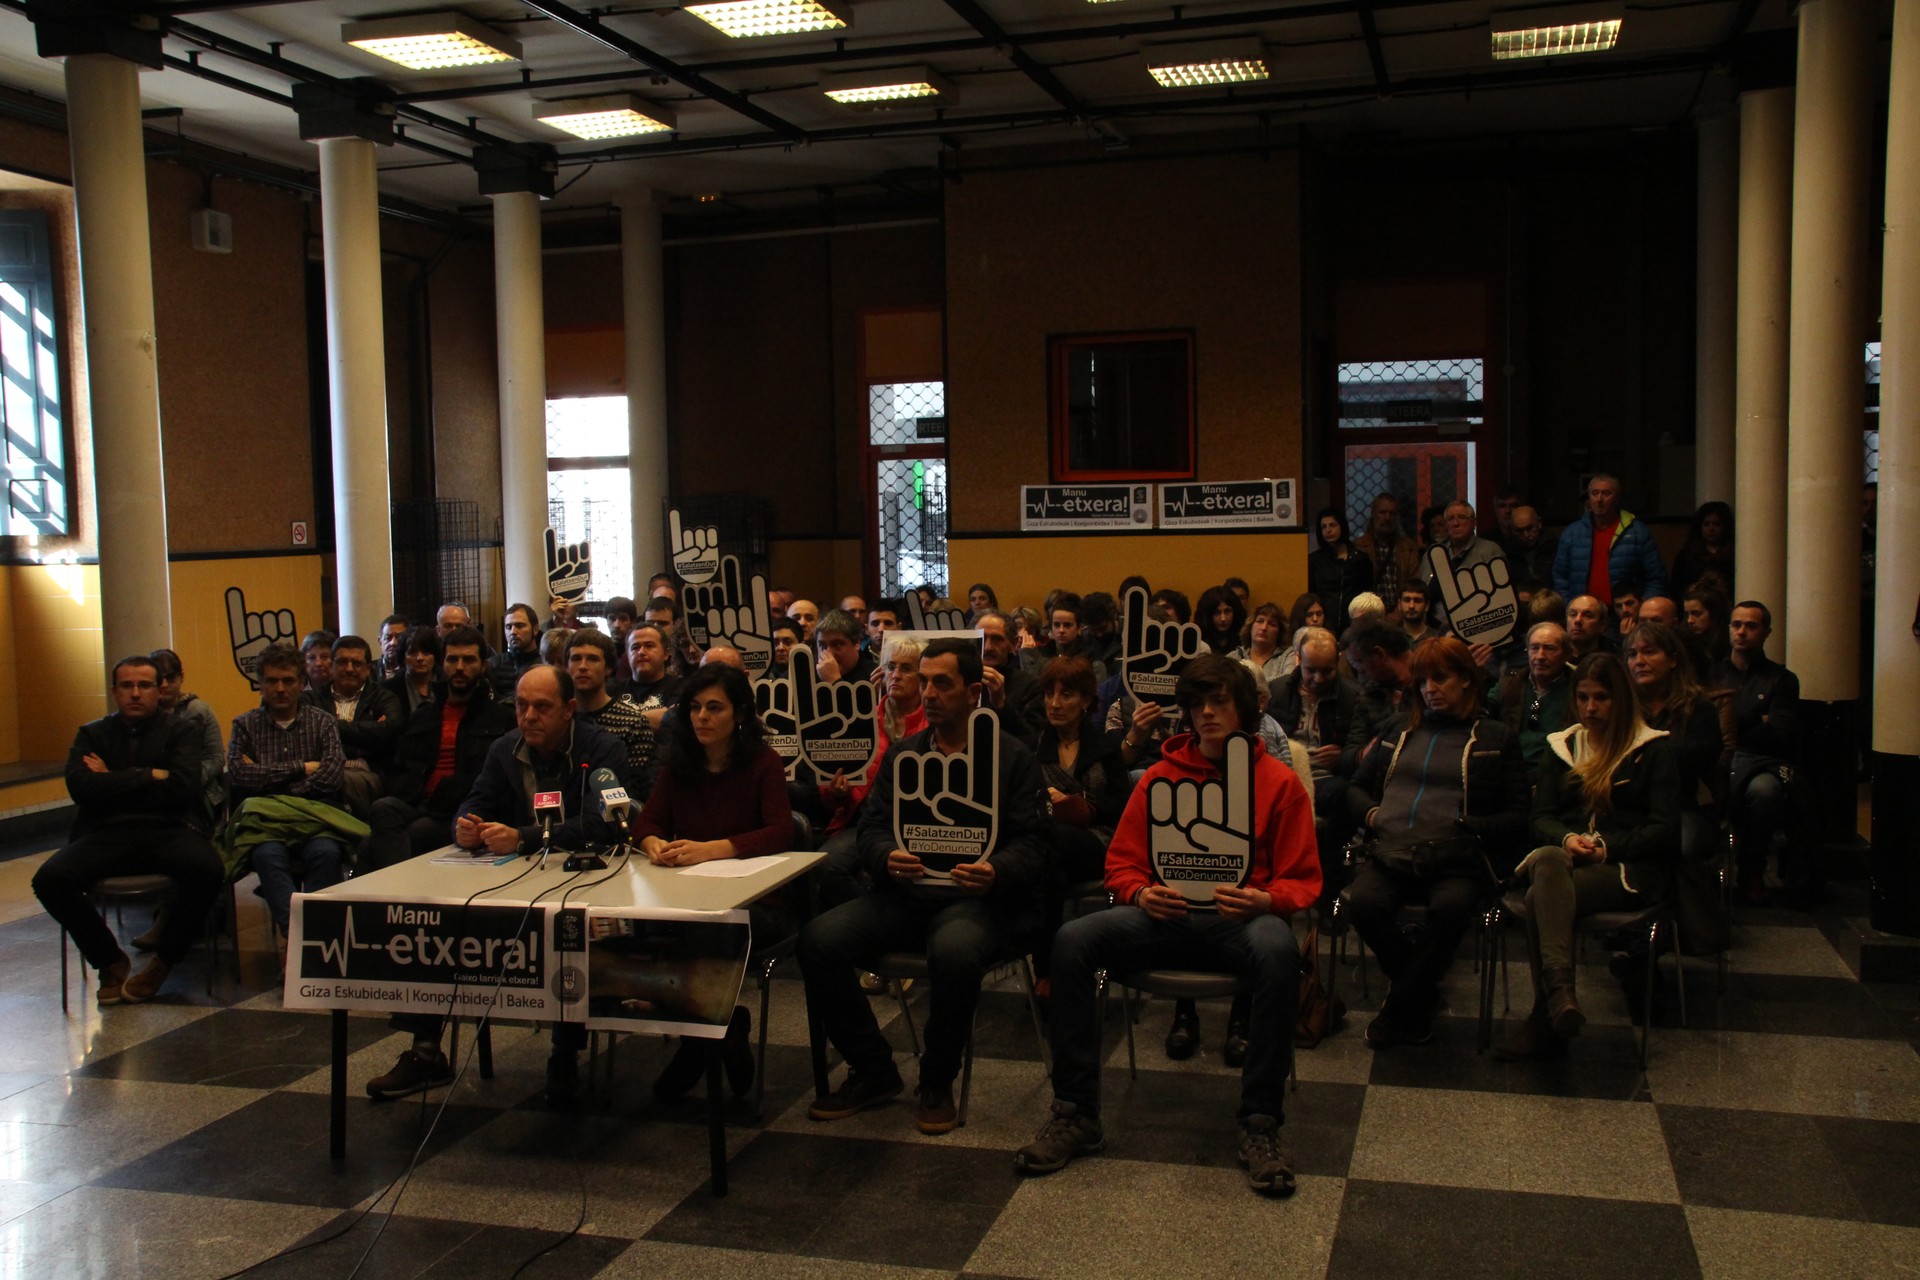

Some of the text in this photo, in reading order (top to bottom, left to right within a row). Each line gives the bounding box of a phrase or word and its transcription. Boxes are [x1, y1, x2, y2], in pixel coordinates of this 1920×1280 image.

[1062, 488, 1087, 497] Manu
[1201, 485, 1227, 494] Manu
[1063, 496, 1128, 513] etxera!
[1203, 491, 1270, 509] etxera!
[1458, 605, 1514, 628] #SalatzenDut
[1131, 674, 1180, 684] #SalatzenD
[807, 740, 870, 750] #SalatzenDut
[812, 752, 867, 760] #YoDenuncio
[605, 791, 626, 800] etb
[906, 826, 985, 840] #SalatzenDut
[911, 841, 980, 854] #YoDenuncio
[1159, 853, 1242, 867] #SalatzenDut
[1165, 869, 1237, 881] #YoDenuncio
[387, 904, 441, 926] Manu
[389, 928, 538, 974] etxera!
[508, 976, 539, 985] etxera!
[300, 985, 331, 998] Giza
[335, 985, 403, 1001] Eskubideak
[413, 989, 496, 1005] Konponbidea
[507, 994, 544, 1009] Bakea
